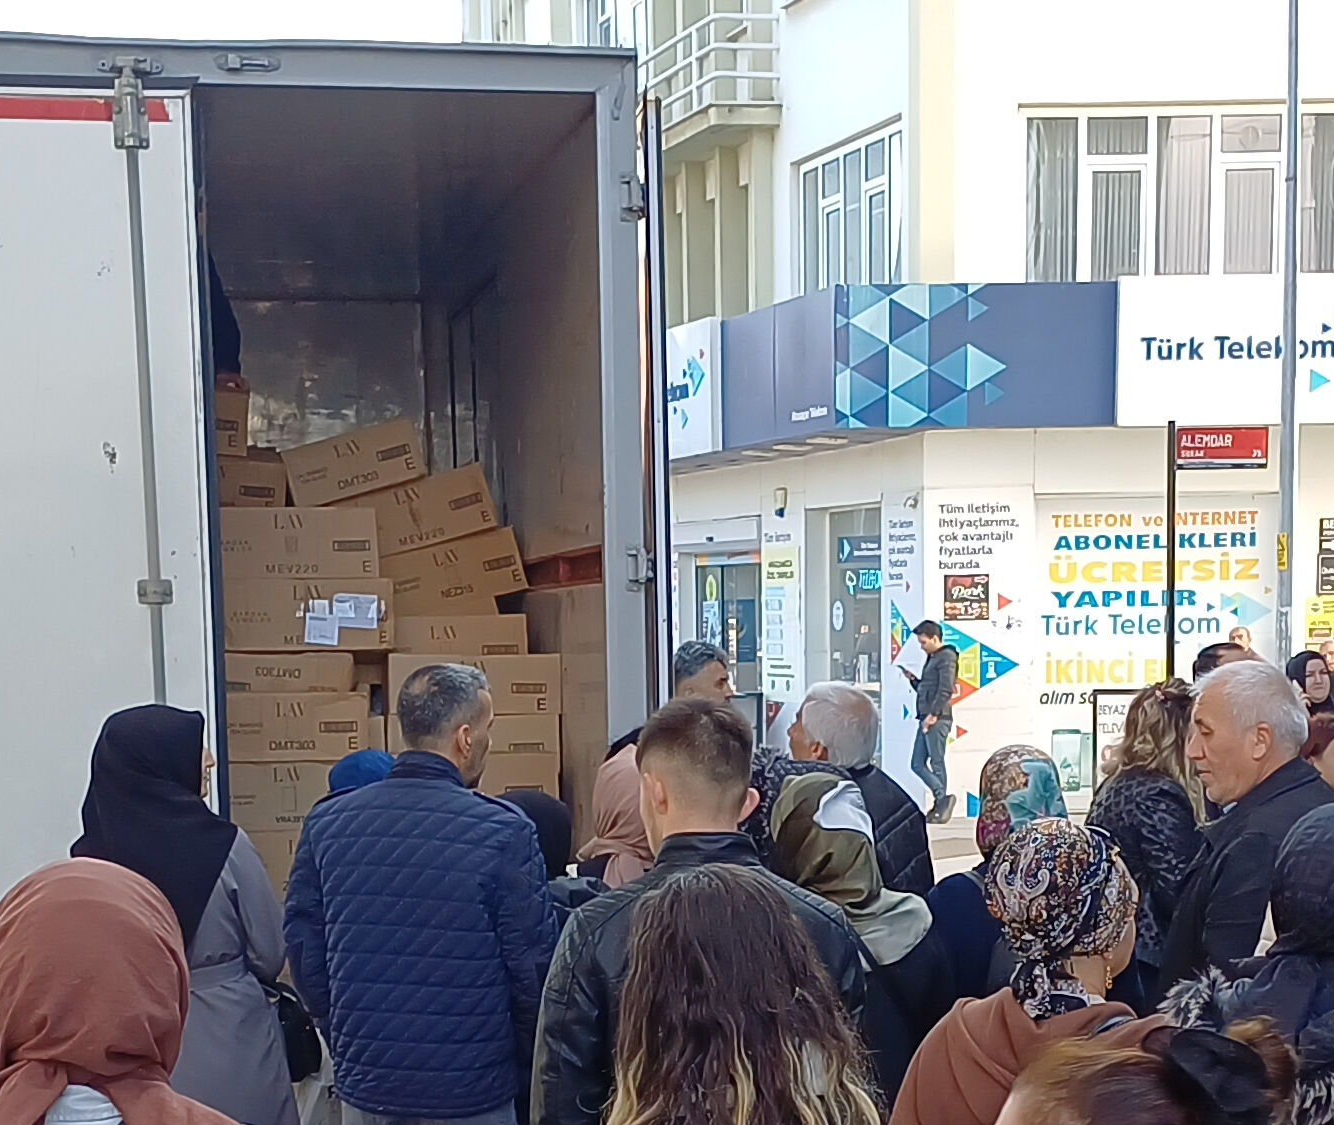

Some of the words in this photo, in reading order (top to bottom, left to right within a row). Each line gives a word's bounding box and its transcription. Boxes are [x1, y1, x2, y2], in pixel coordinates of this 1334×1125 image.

[1140, 335, 1204, 361] Türk
[1180, 434, 1233, 448] ALEMDAR
[404, 457, 416, 471] E
[938, 503, 964, 514] Tüm
[480, 510, 492, 523] E
[1051, 513, 1132, 529] TELEFON
[1174, 510, 1259, 527] NTERNET
[938, 532, 959, 544] çok
[961, 531, 1014, 542] avantajlı
[1053, 527, 1257, 551] ABONELKLERİ
[938, 545, 993, 558] fiyatlarla
[265, 564, 319, 574] MEV220
[363, 560, 372, 573] E
[938, 559, 980, 569] burada
[511, 569, 522, 583] E
[1041, 614, 1098, 636] Türk
[379, 631, 388, 644] E
[1045, 651, 1134, 684] İKİNCİ
[1039, 690, 1075, 705] alım
[536, 698, 547, 711] E
[269, 740, 316, 751] DMT303
[348, 736, 358, 750] E
